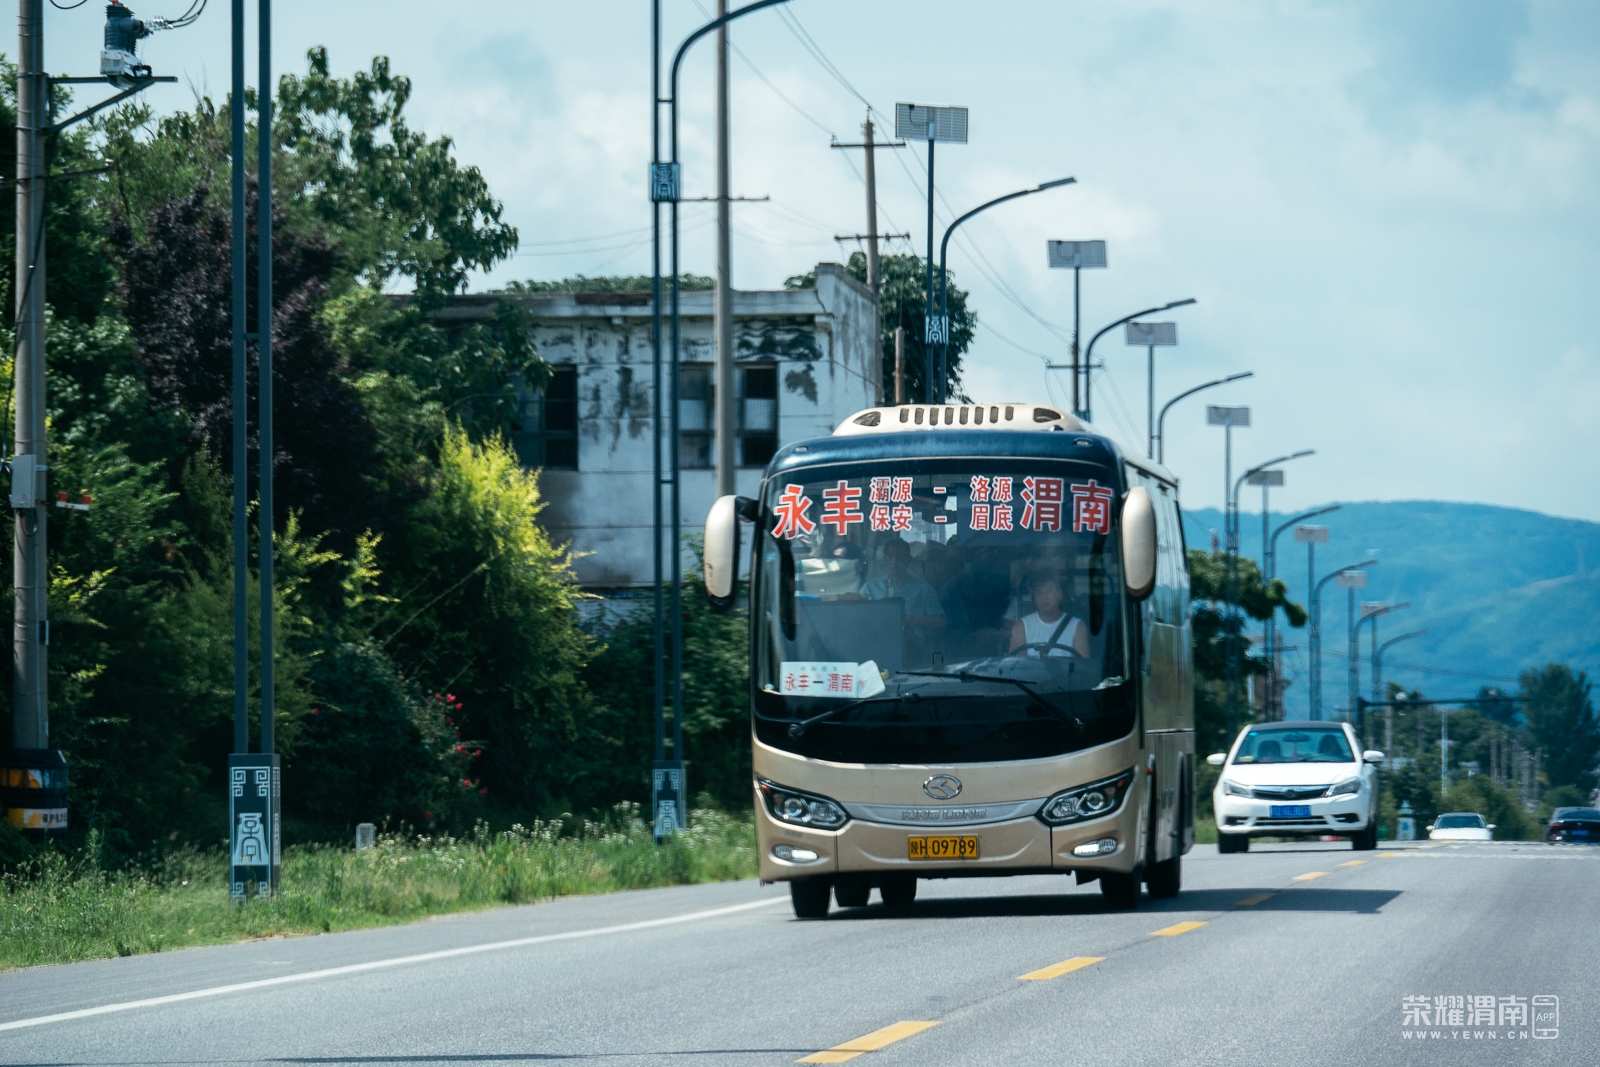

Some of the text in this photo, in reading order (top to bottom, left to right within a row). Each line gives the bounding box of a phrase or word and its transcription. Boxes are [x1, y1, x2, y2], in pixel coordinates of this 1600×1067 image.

[869, 475, 1013, 503] 灞源 洛源
[771, 480, 863, 539] 永丰
[869, 503, 1013, 531] 保安 眉底
[1020, 476, 1114, 535] 渭南
[902, 808, 987, 820] KING LONG
